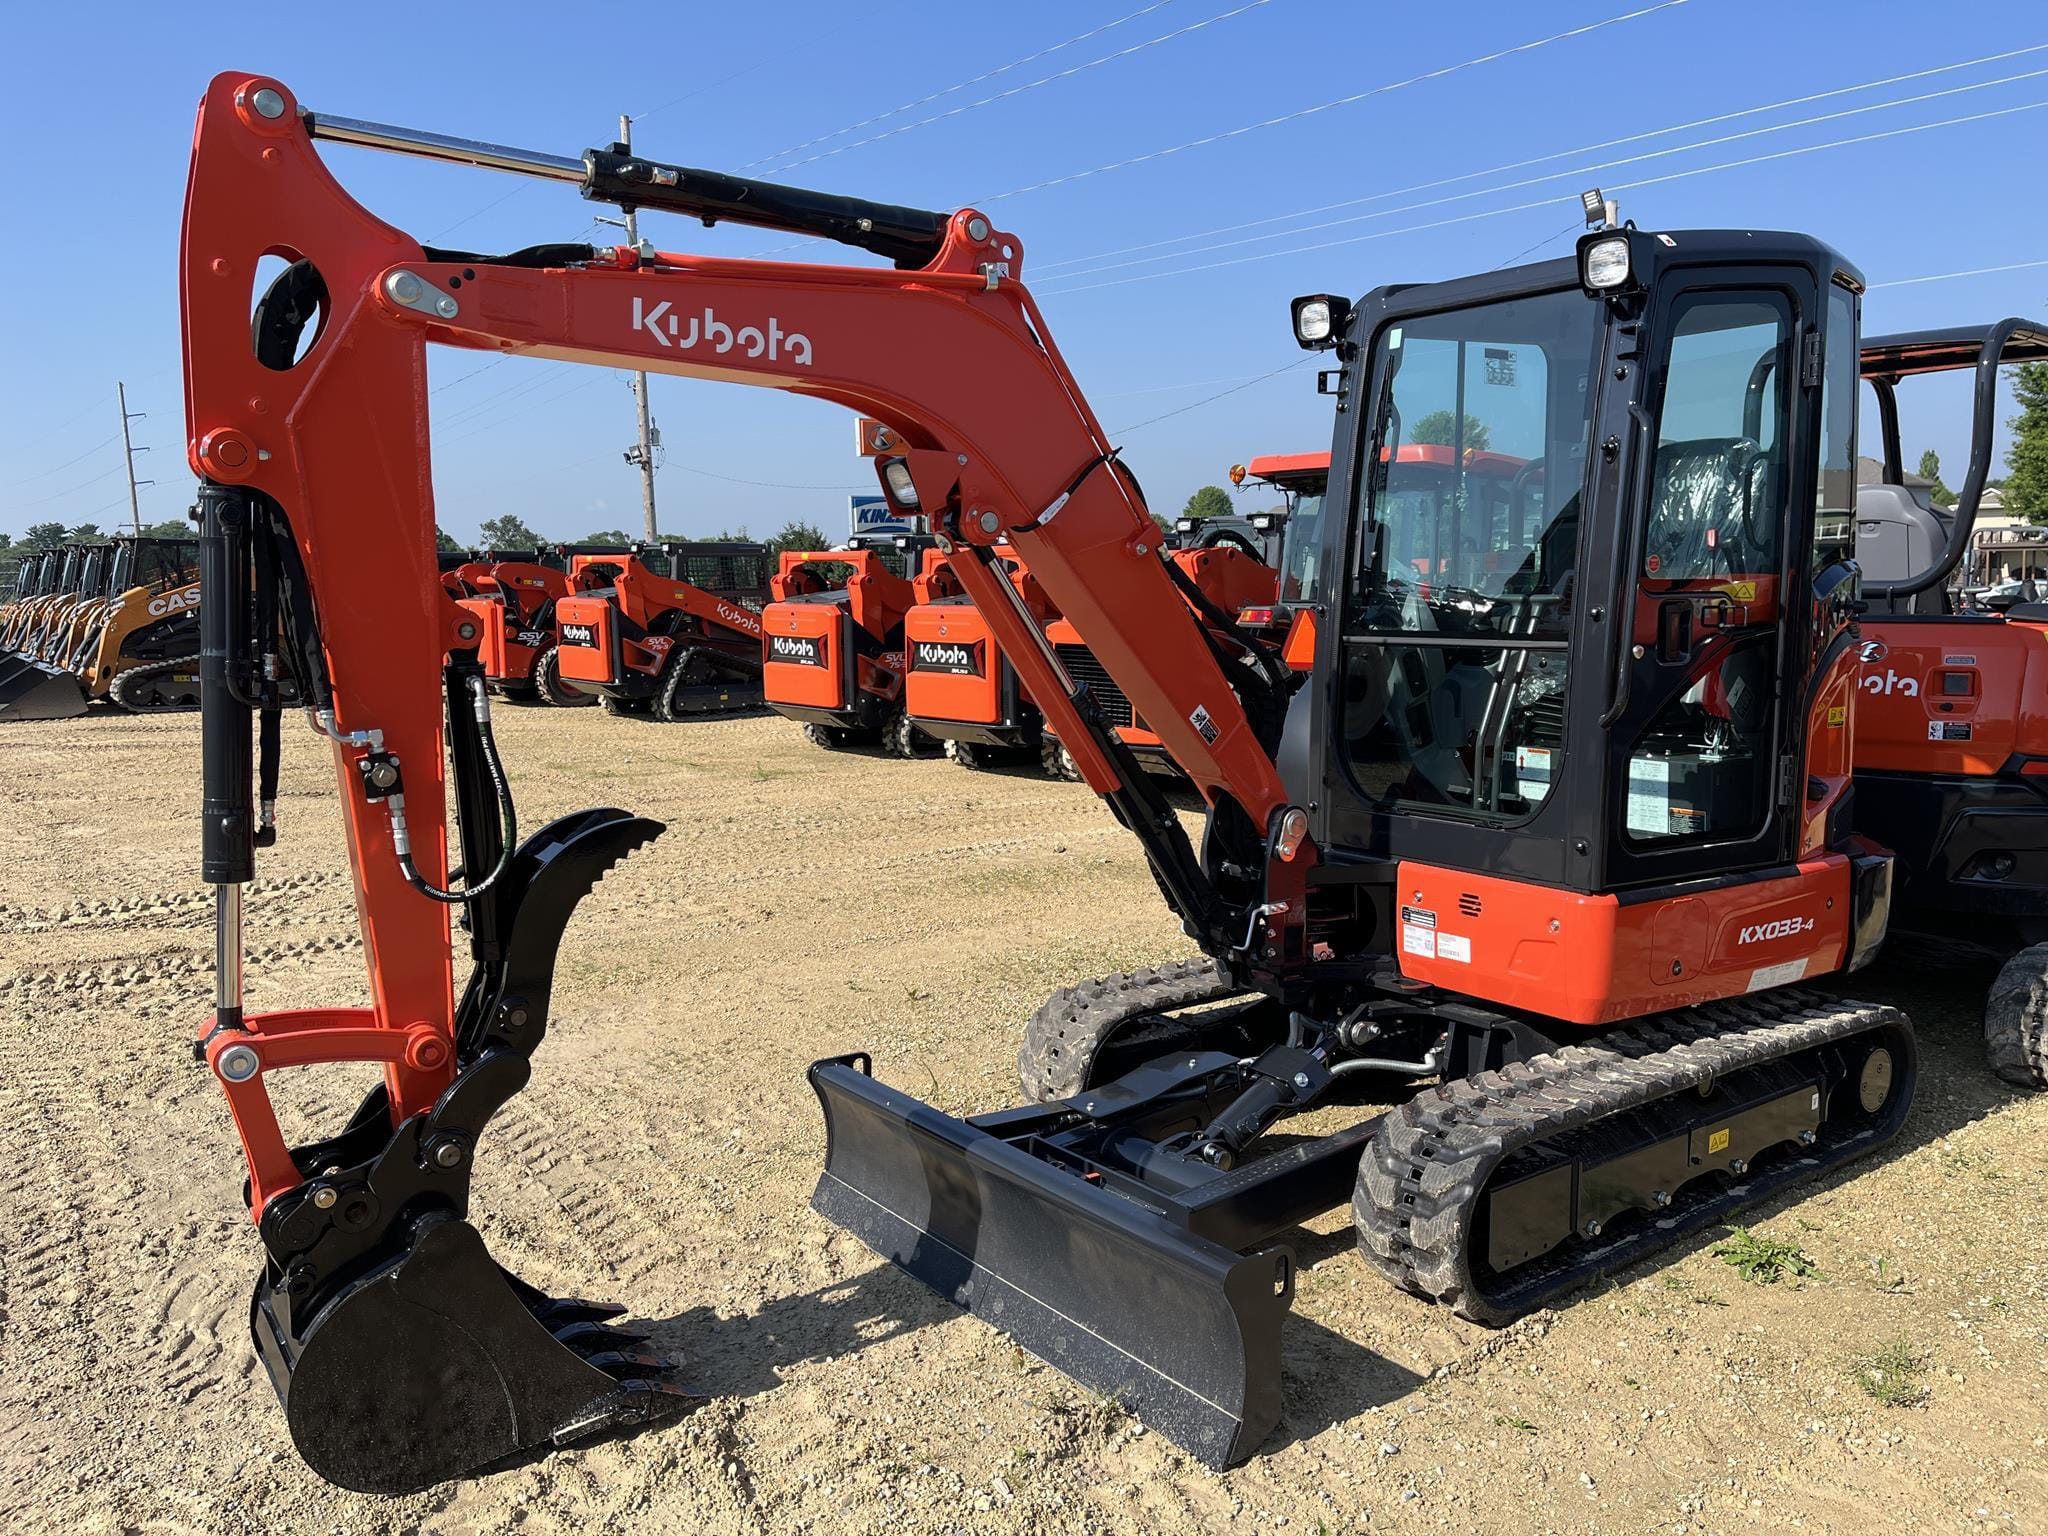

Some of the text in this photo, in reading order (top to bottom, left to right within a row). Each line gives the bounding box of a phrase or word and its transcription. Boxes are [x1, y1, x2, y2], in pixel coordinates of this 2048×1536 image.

[632, 296, 813, 366] Kubota
[147, 588, 202, 616] CAS
[716, 603, 761, 633] Kubota
[517, 631, 545, 640] SSV
[563, 624, 591, 641] Kubota
[647, 638, 667, 646] SVL
[774, 637, 814, 657] Kubota
[920, 643, 968, 665] Kubota
[884, 654, 906, 663] SVL
[1858, 669, 1919, 697] ota
[1737, 916, 1815, 945] KX033-4
